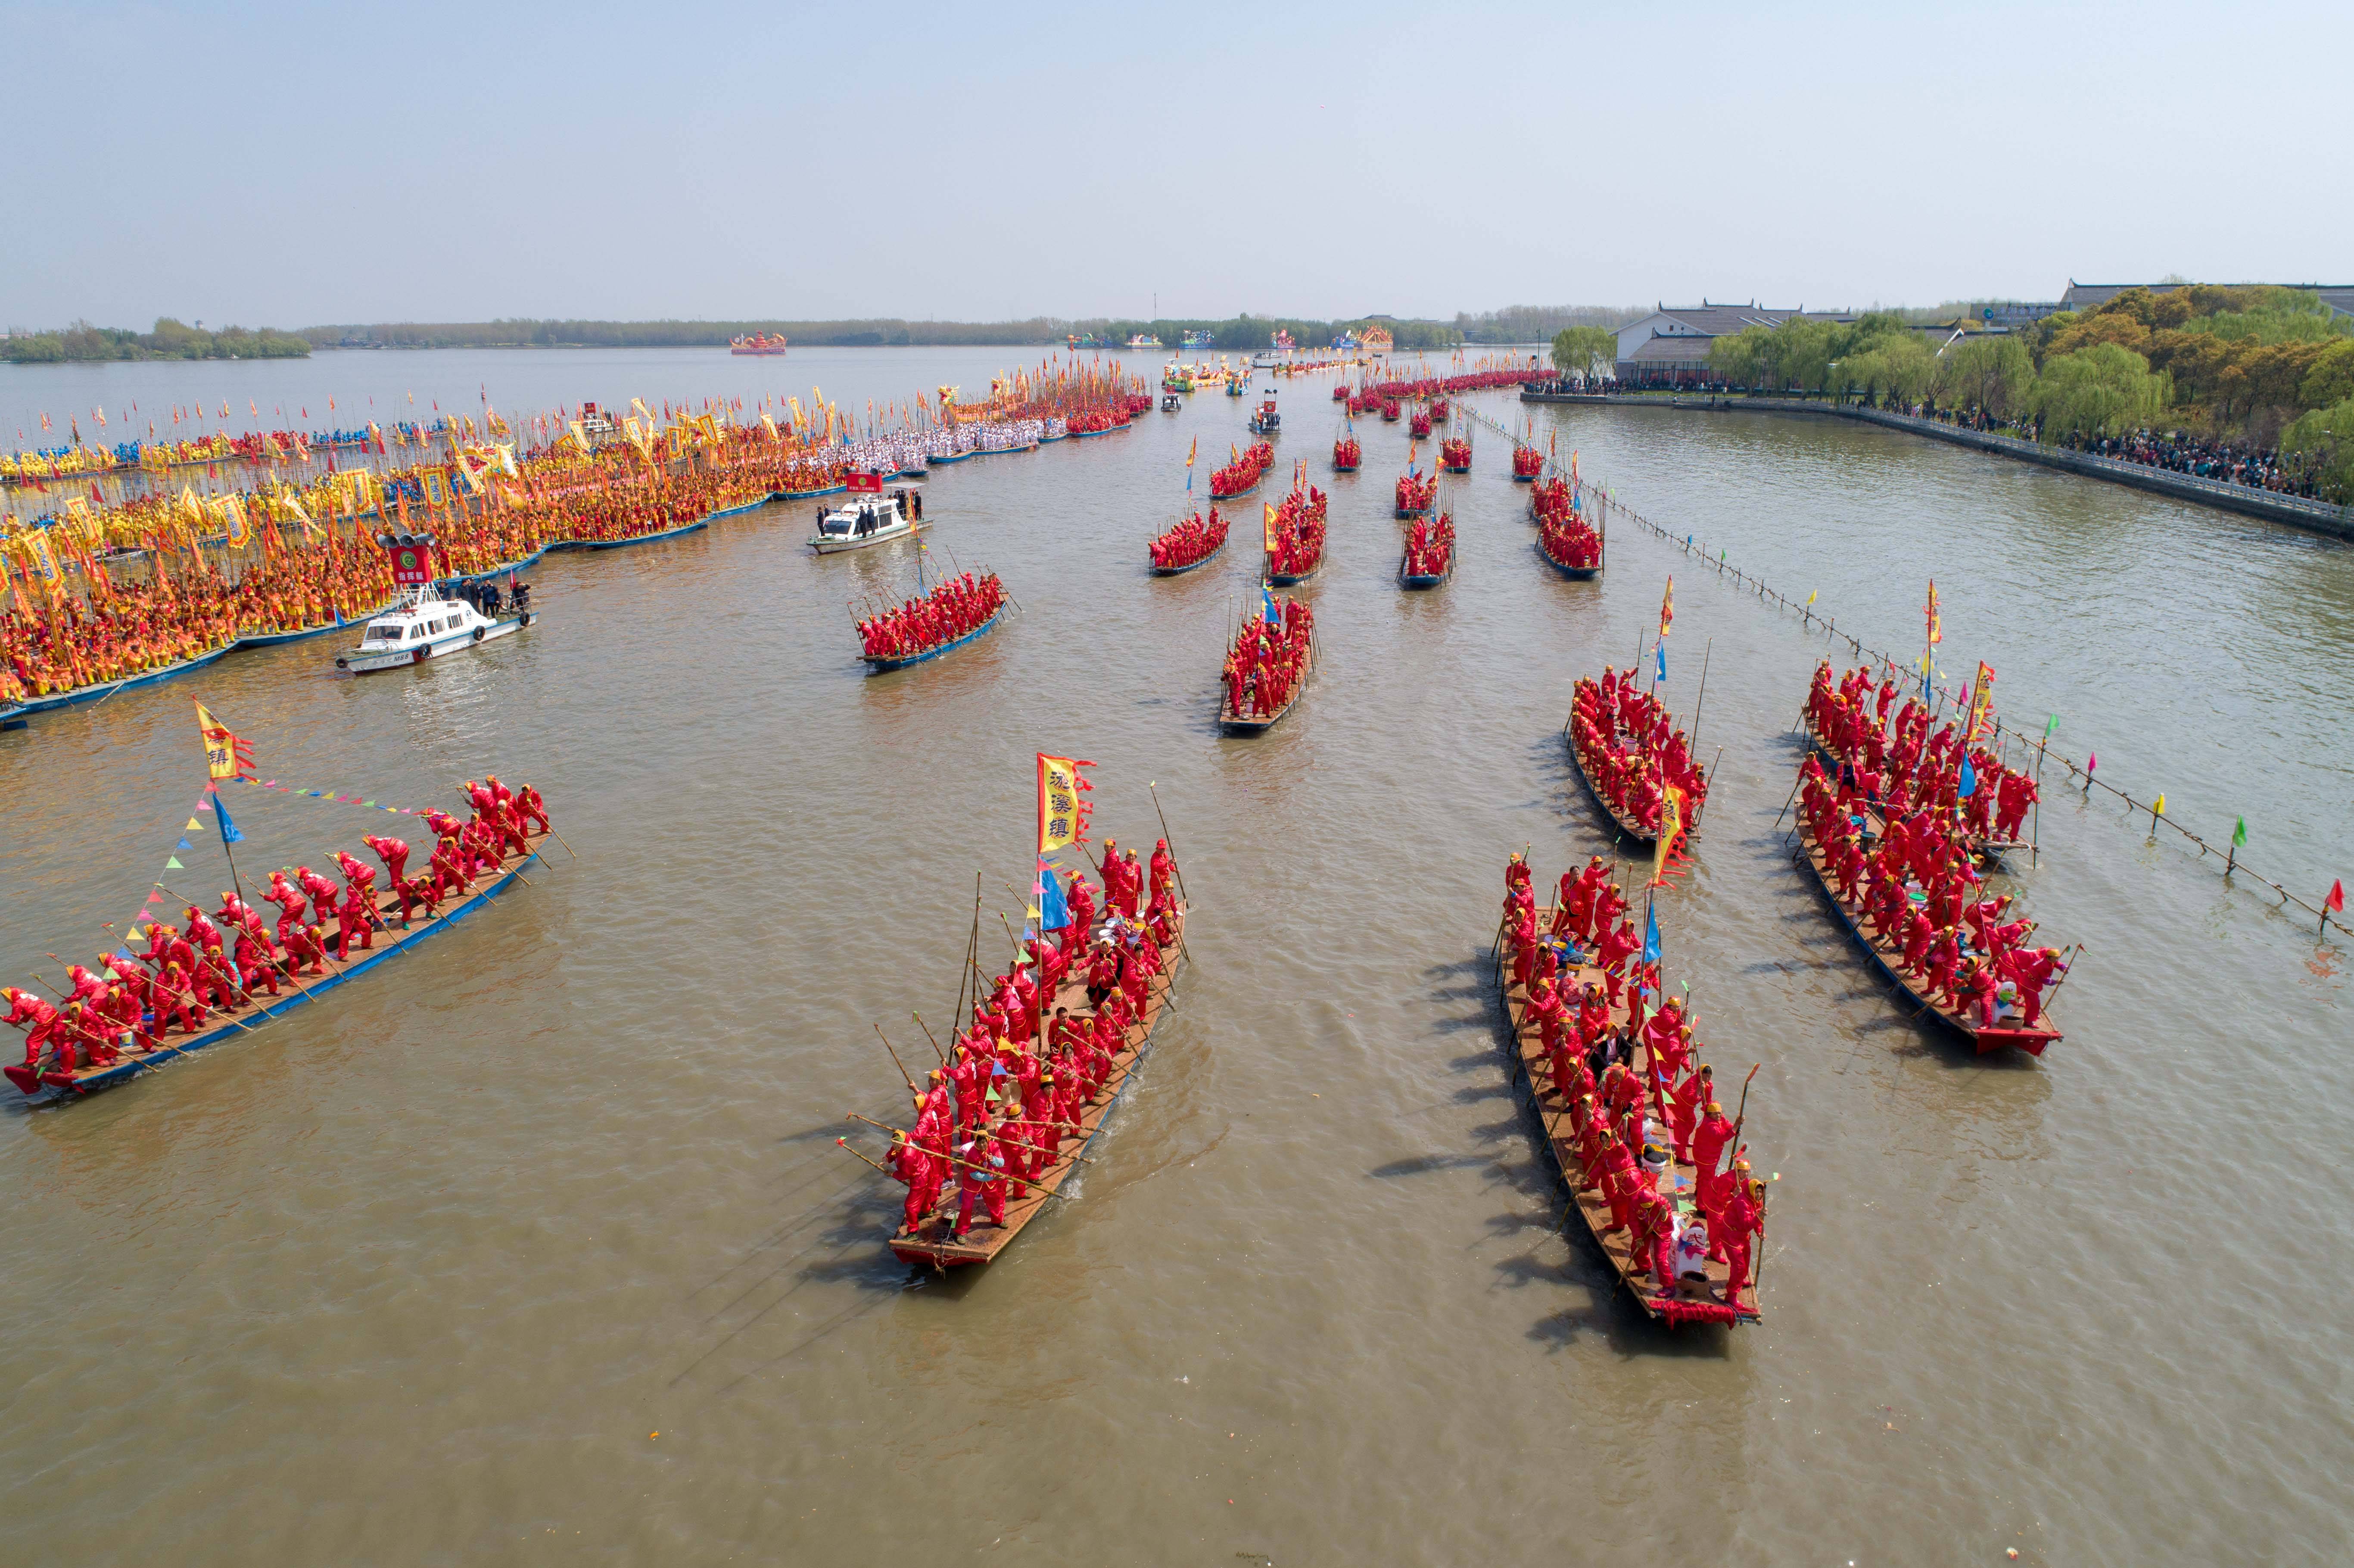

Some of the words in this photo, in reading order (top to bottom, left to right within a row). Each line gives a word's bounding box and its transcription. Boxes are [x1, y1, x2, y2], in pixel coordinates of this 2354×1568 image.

[429, 475, 442, 502] 开发区
[398, 572, 424, 581] 指挥艇
[1048, 771, 1072, 837] 淤溪镇
